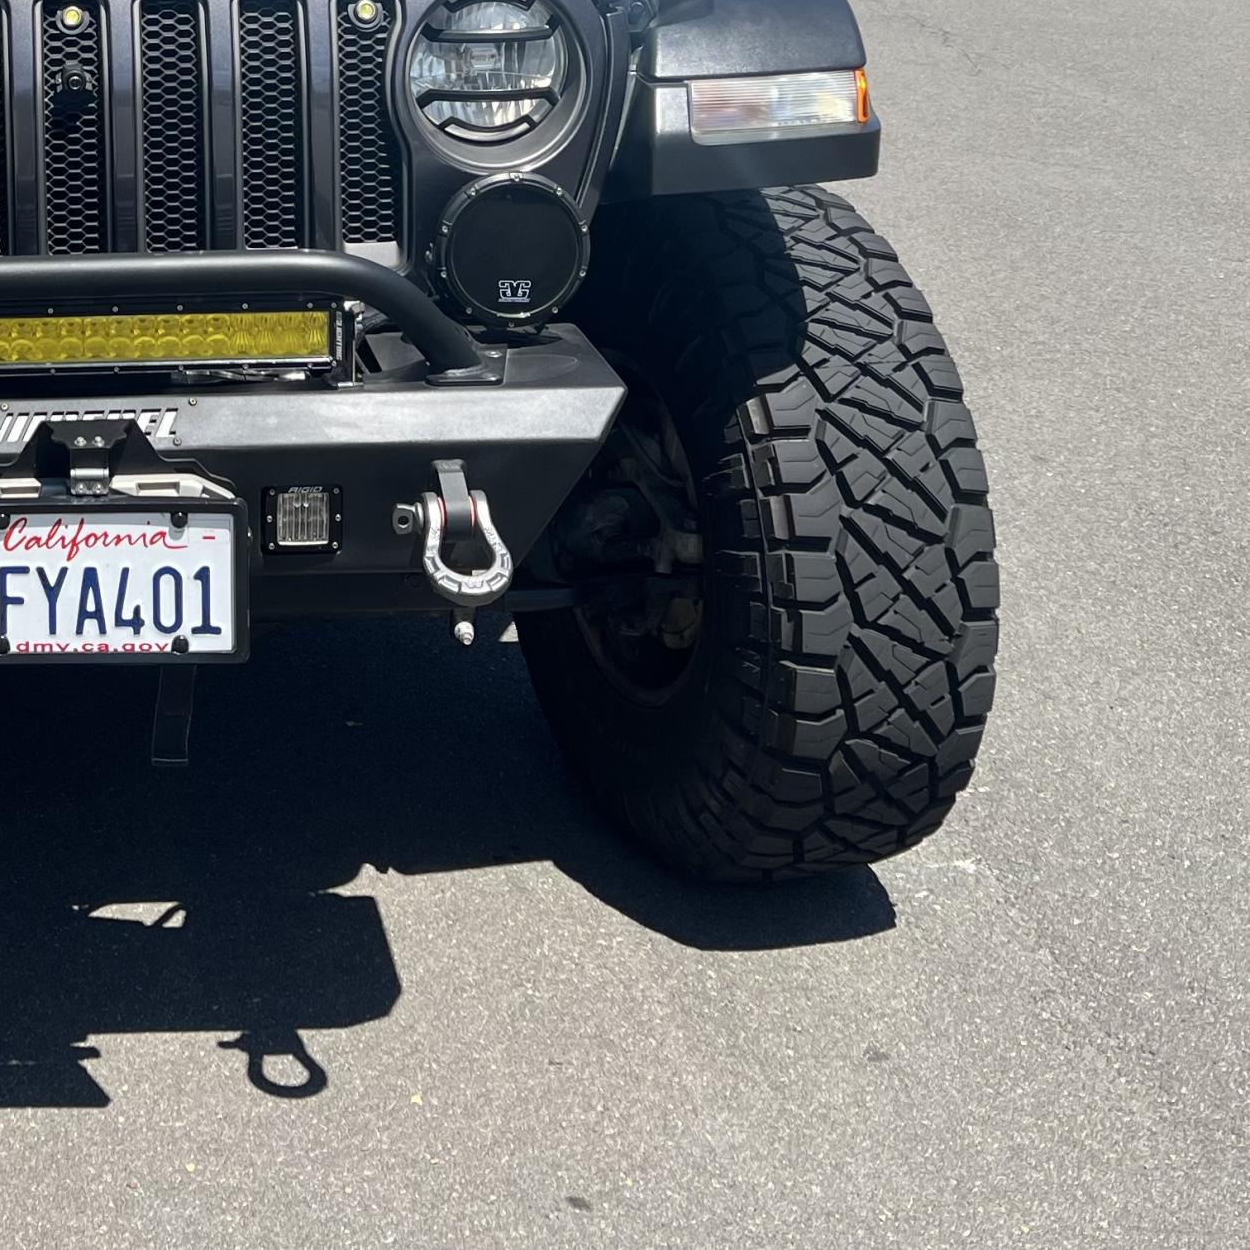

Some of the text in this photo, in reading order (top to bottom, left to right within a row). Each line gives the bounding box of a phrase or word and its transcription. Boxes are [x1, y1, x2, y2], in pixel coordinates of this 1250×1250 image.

[288, 486, 323, 494] RIGID
[3, 517, 188, 562] California
[16, 640, 169, 654] dmv.ca.gov
